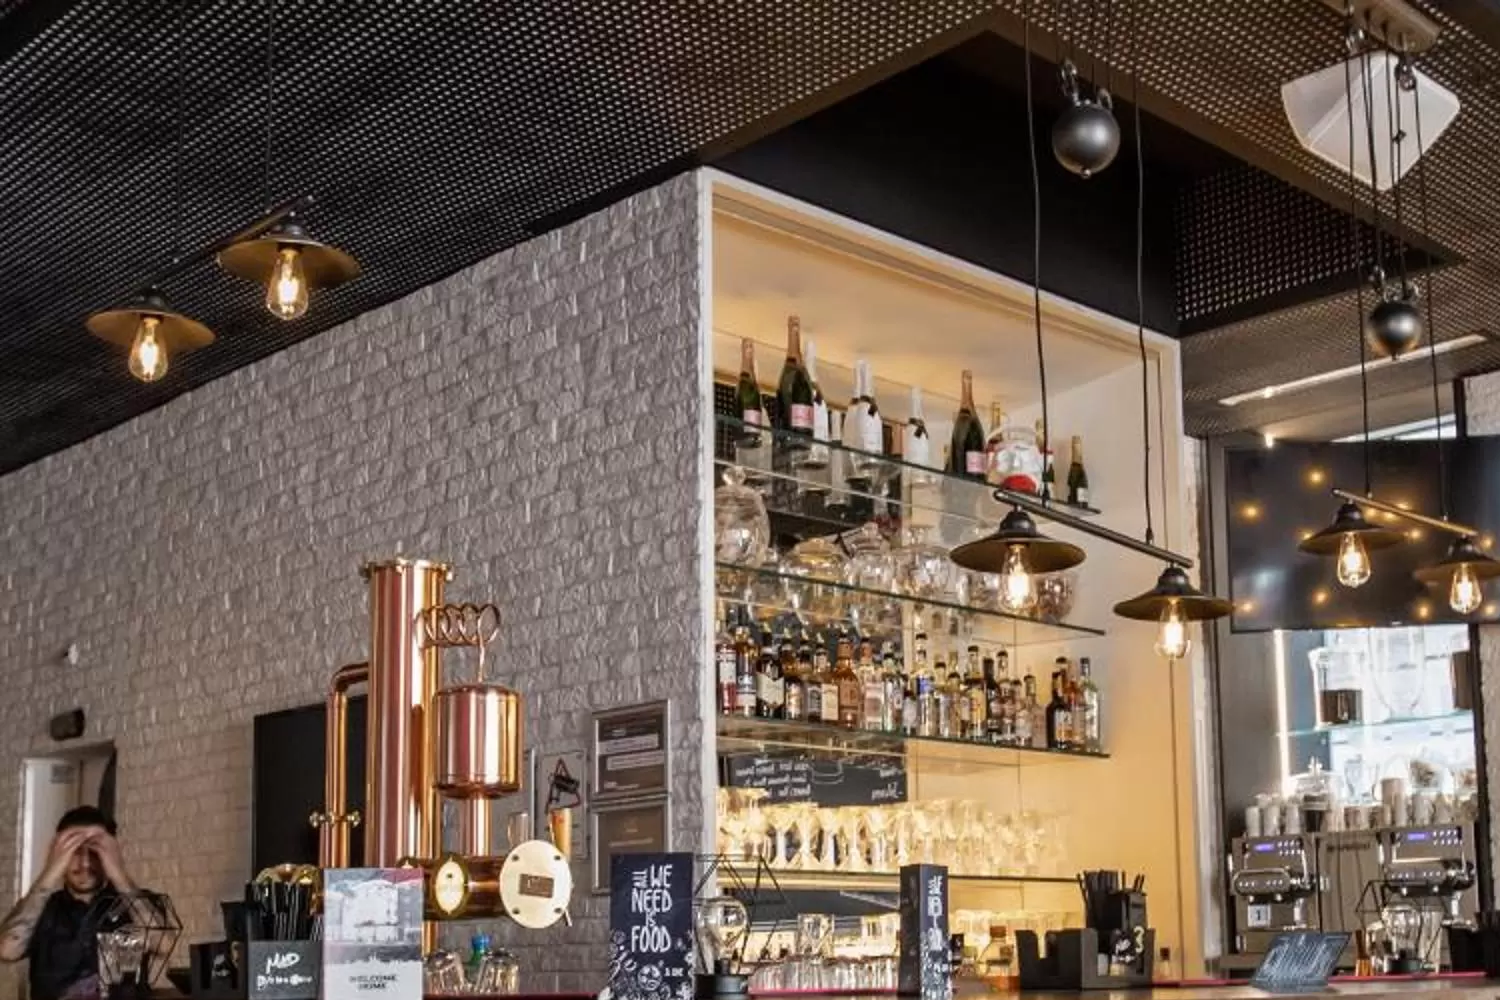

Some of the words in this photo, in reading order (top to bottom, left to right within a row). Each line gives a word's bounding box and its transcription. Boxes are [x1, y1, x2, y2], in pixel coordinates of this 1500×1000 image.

[650, 864, 673, 888] WE
[631, 887, 673, 913] NEED
[631, 925, 672, 953] FOOD
